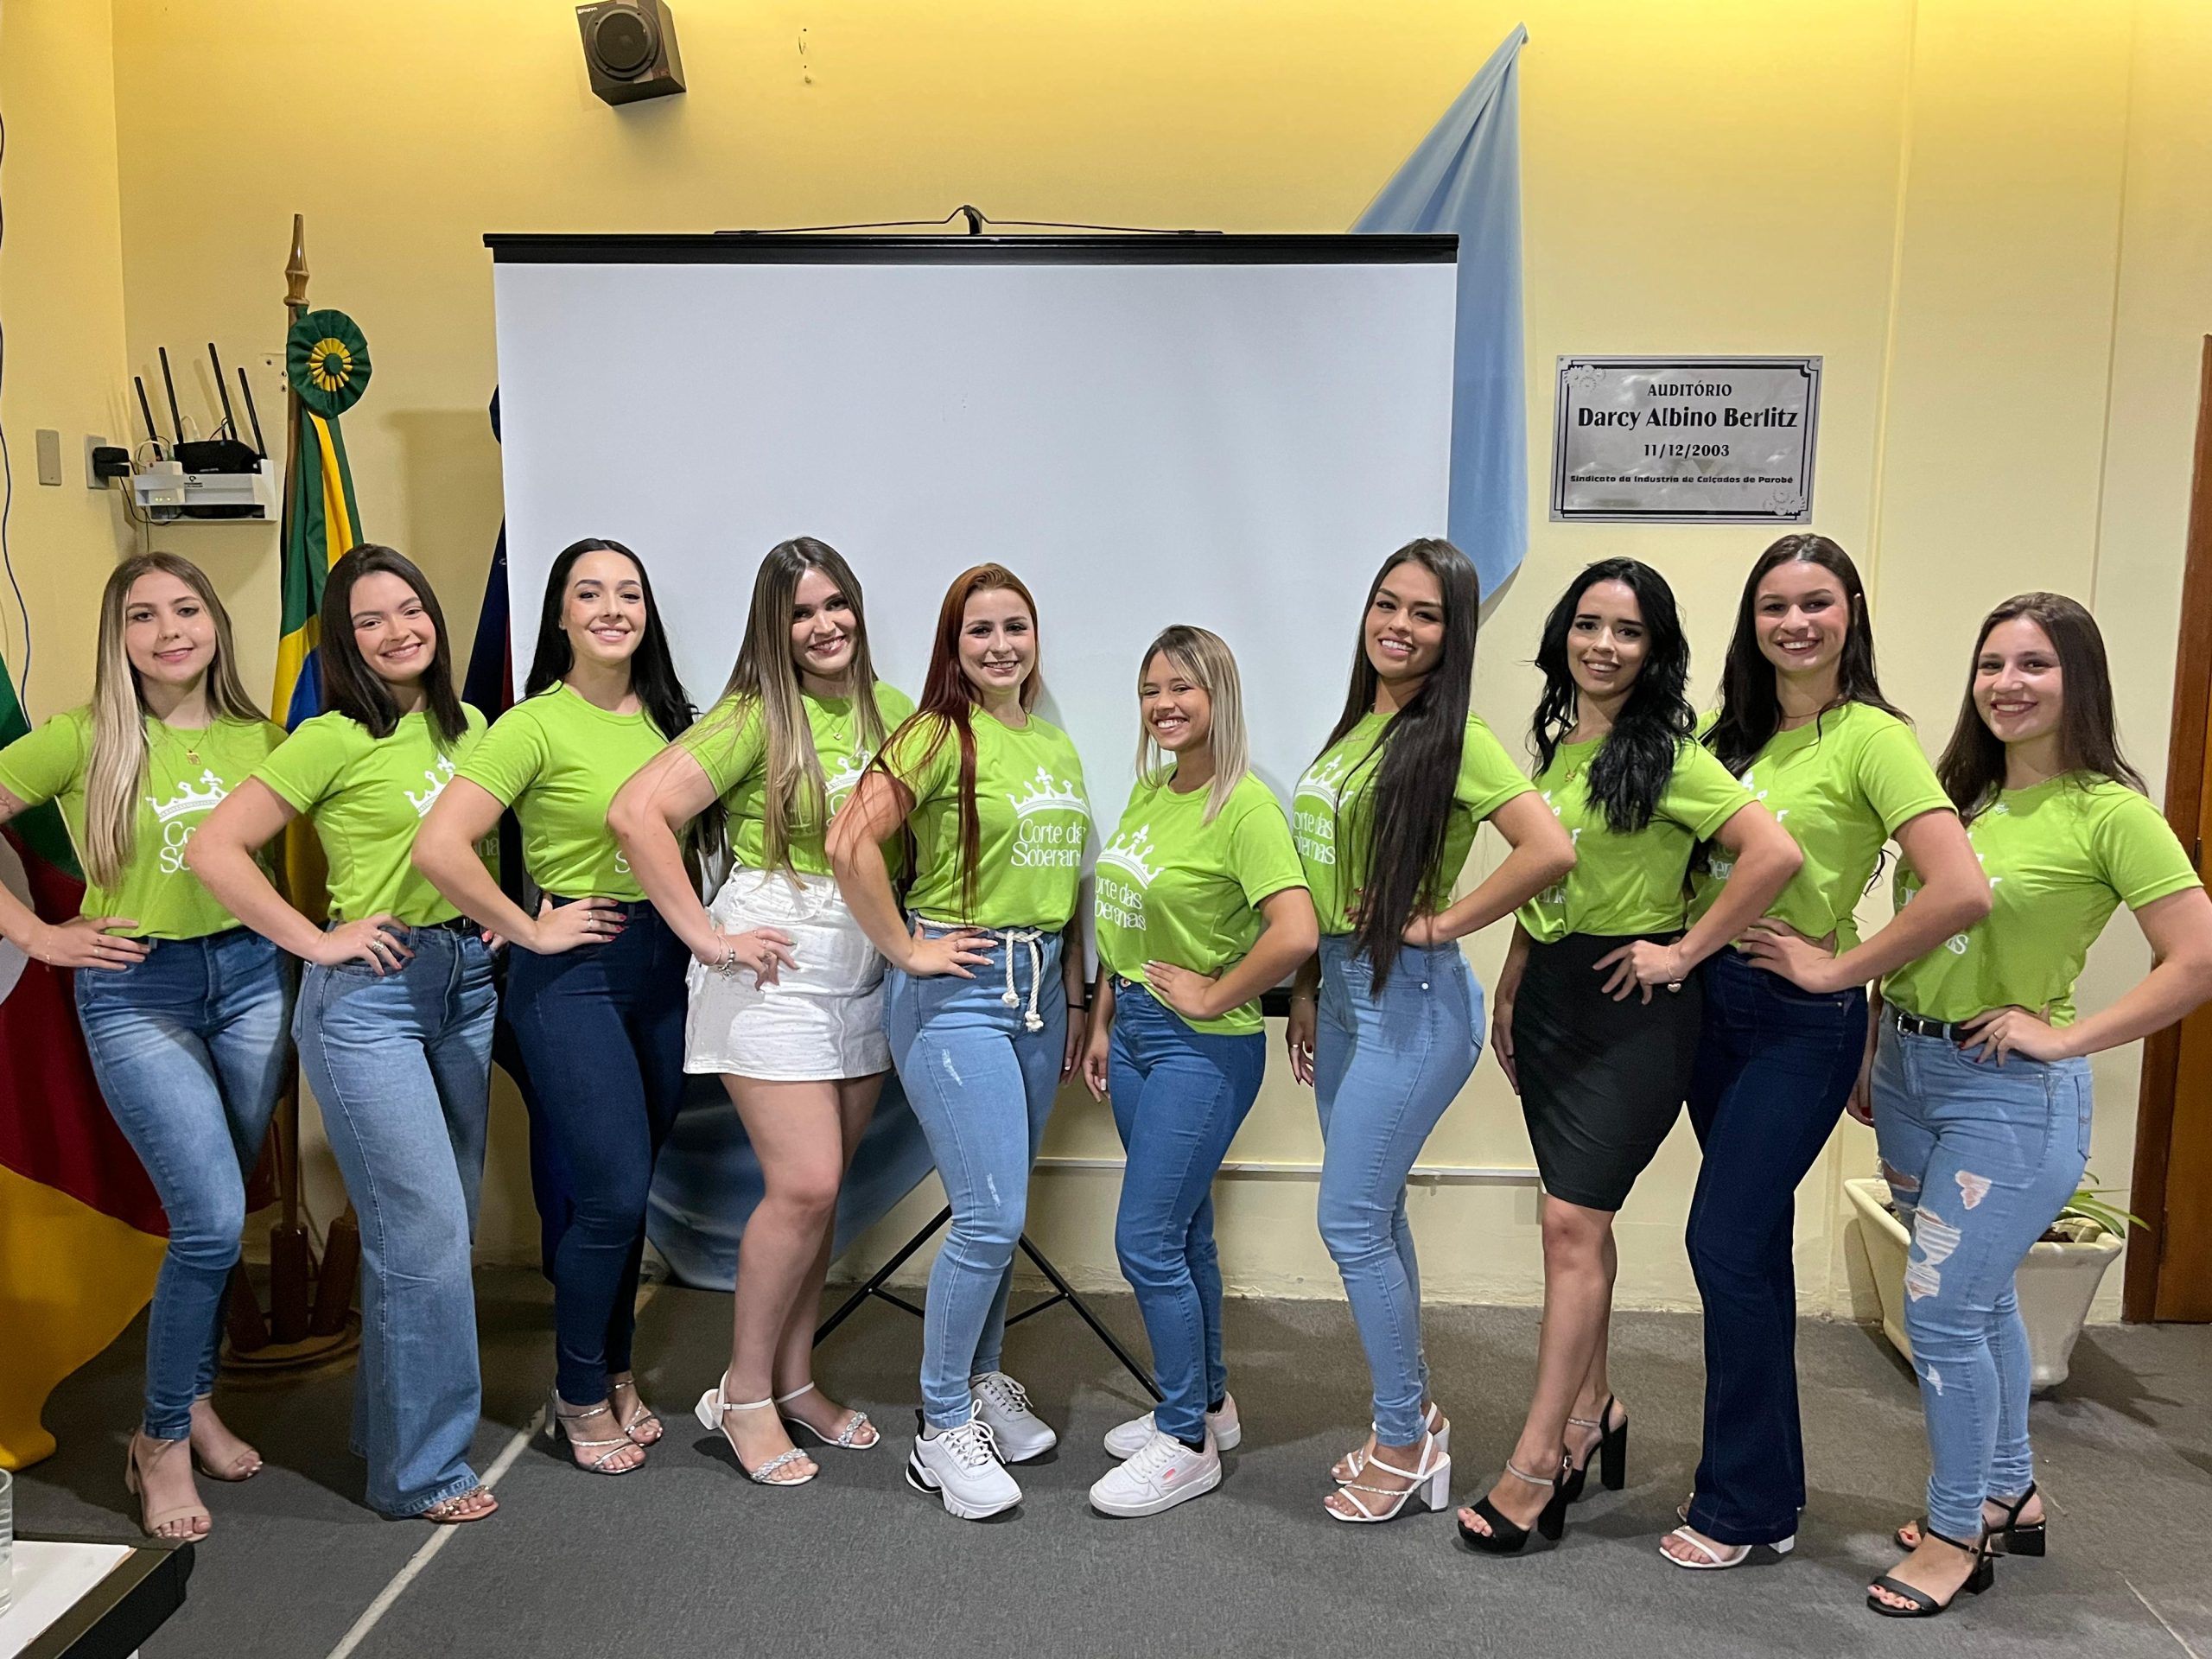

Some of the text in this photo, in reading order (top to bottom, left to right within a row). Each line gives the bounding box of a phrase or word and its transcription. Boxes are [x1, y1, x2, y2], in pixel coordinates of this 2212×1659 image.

[1647, 379, 1732, 397] AUDITÓRIO
[1578, 406, 1798, 431] Darcy Albino Berlitz
[1644, 443, 1730, 459] 11/12/2003
[1634, 475, 1679, 484] Industria
[1020, 818, 1063, 844] Corte
[1293, 810, 1314, 833] orte
[1011, 841, 1082, 867] Soberan
[1095, 875, 1142, 910] orte das
